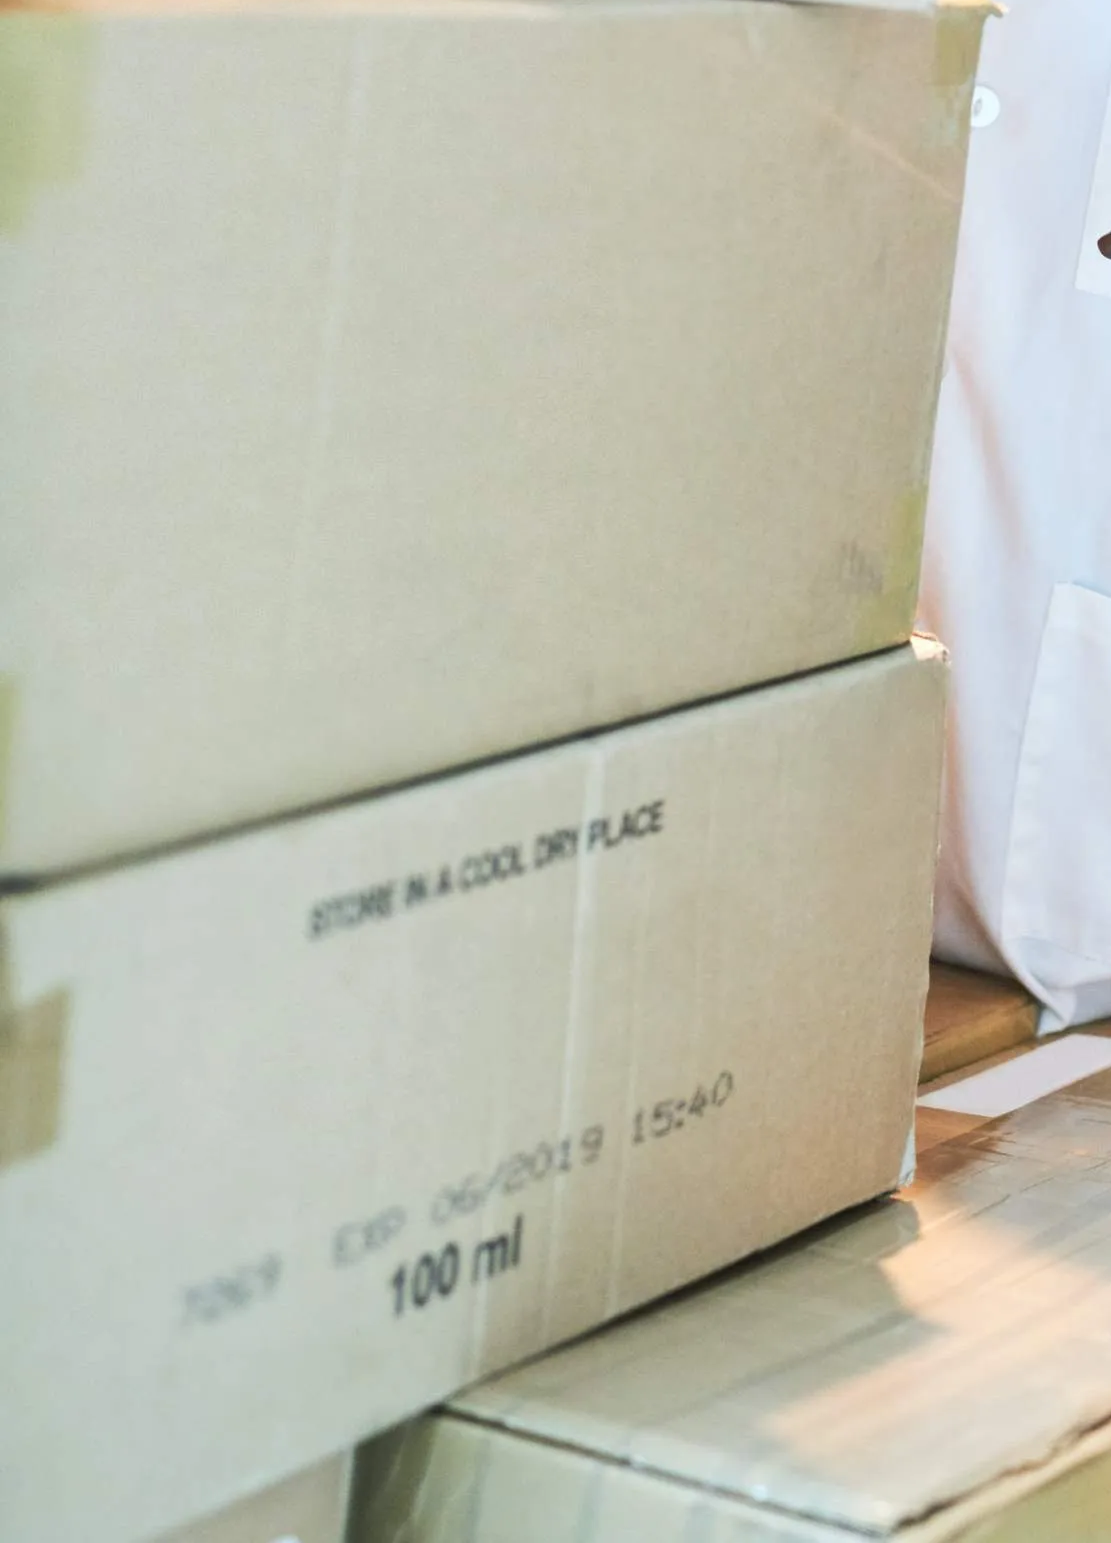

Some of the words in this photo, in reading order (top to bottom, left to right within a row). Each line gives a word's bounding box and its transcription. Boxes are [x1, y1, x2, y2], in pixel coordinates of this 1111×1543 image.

[309, 882, 395, 939] STORE
[404, 872, 429, 909] IN
[435, 861, 453, 898] A
[459, 843, 526, 893] COOL
[534, 825, 581, 870] DRY
[586, 799, 665, 855] PLACE
[332, 1205, 408, 1270] EXP
[430, 1123, 604, 1228] 06/2019
[631, 1069, 734, 1145] 15:40
[390, 1240, 462, 1319] 100
[471, 1211, 524, 1286] ml
